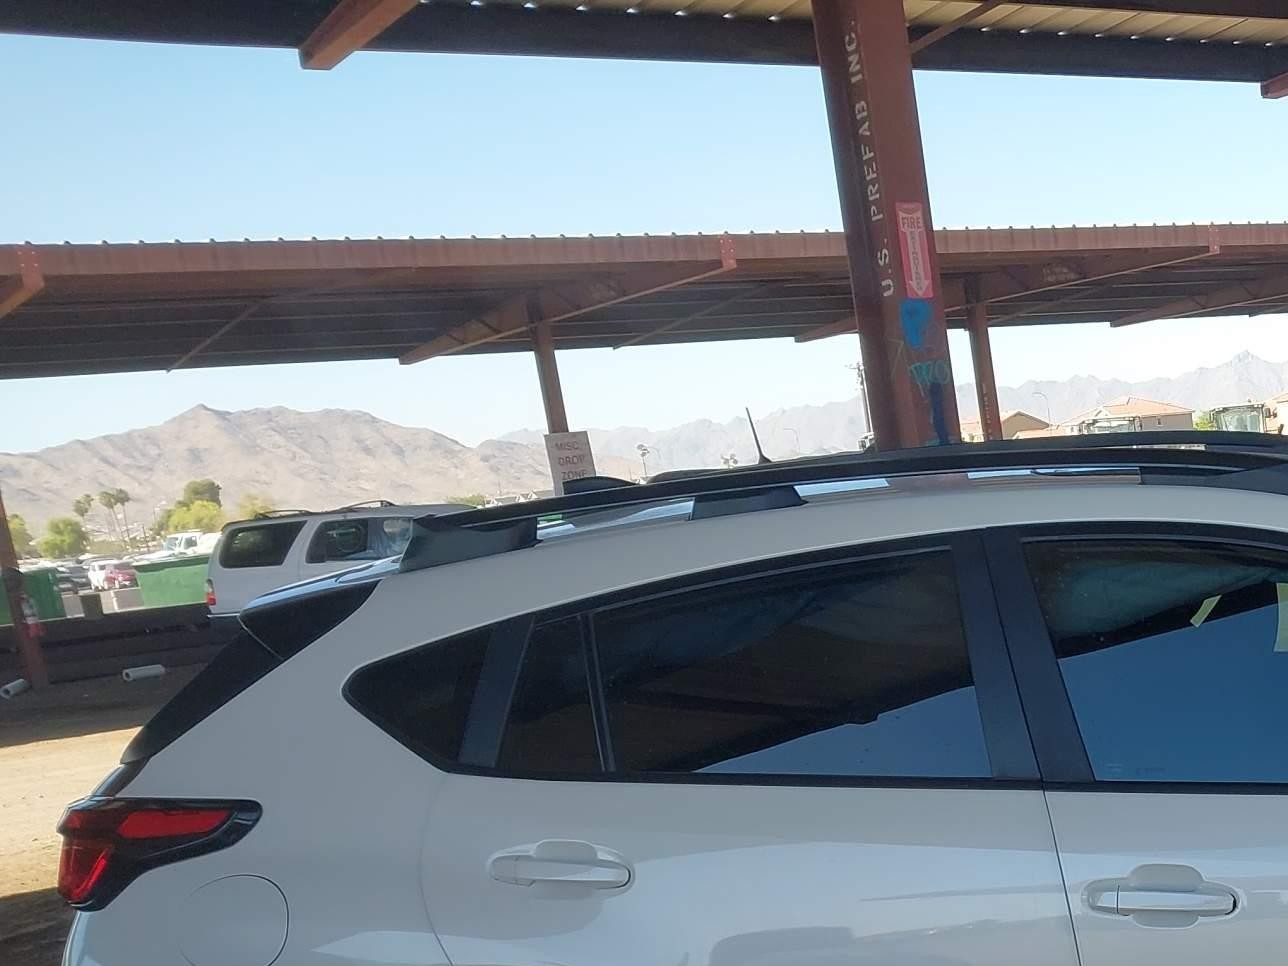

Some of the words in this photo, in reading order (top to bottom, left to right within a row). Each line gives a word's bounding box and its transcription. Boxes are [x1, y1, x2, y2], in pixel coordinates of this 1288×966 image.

[844, 20, 865, 84] INC.
[854, 99, 884, 222] PREFAB
[900, 215, 922, 229] FIRE
[877, 236, 895, 297] U.S.
[558, 455, 586, 466] DROP
